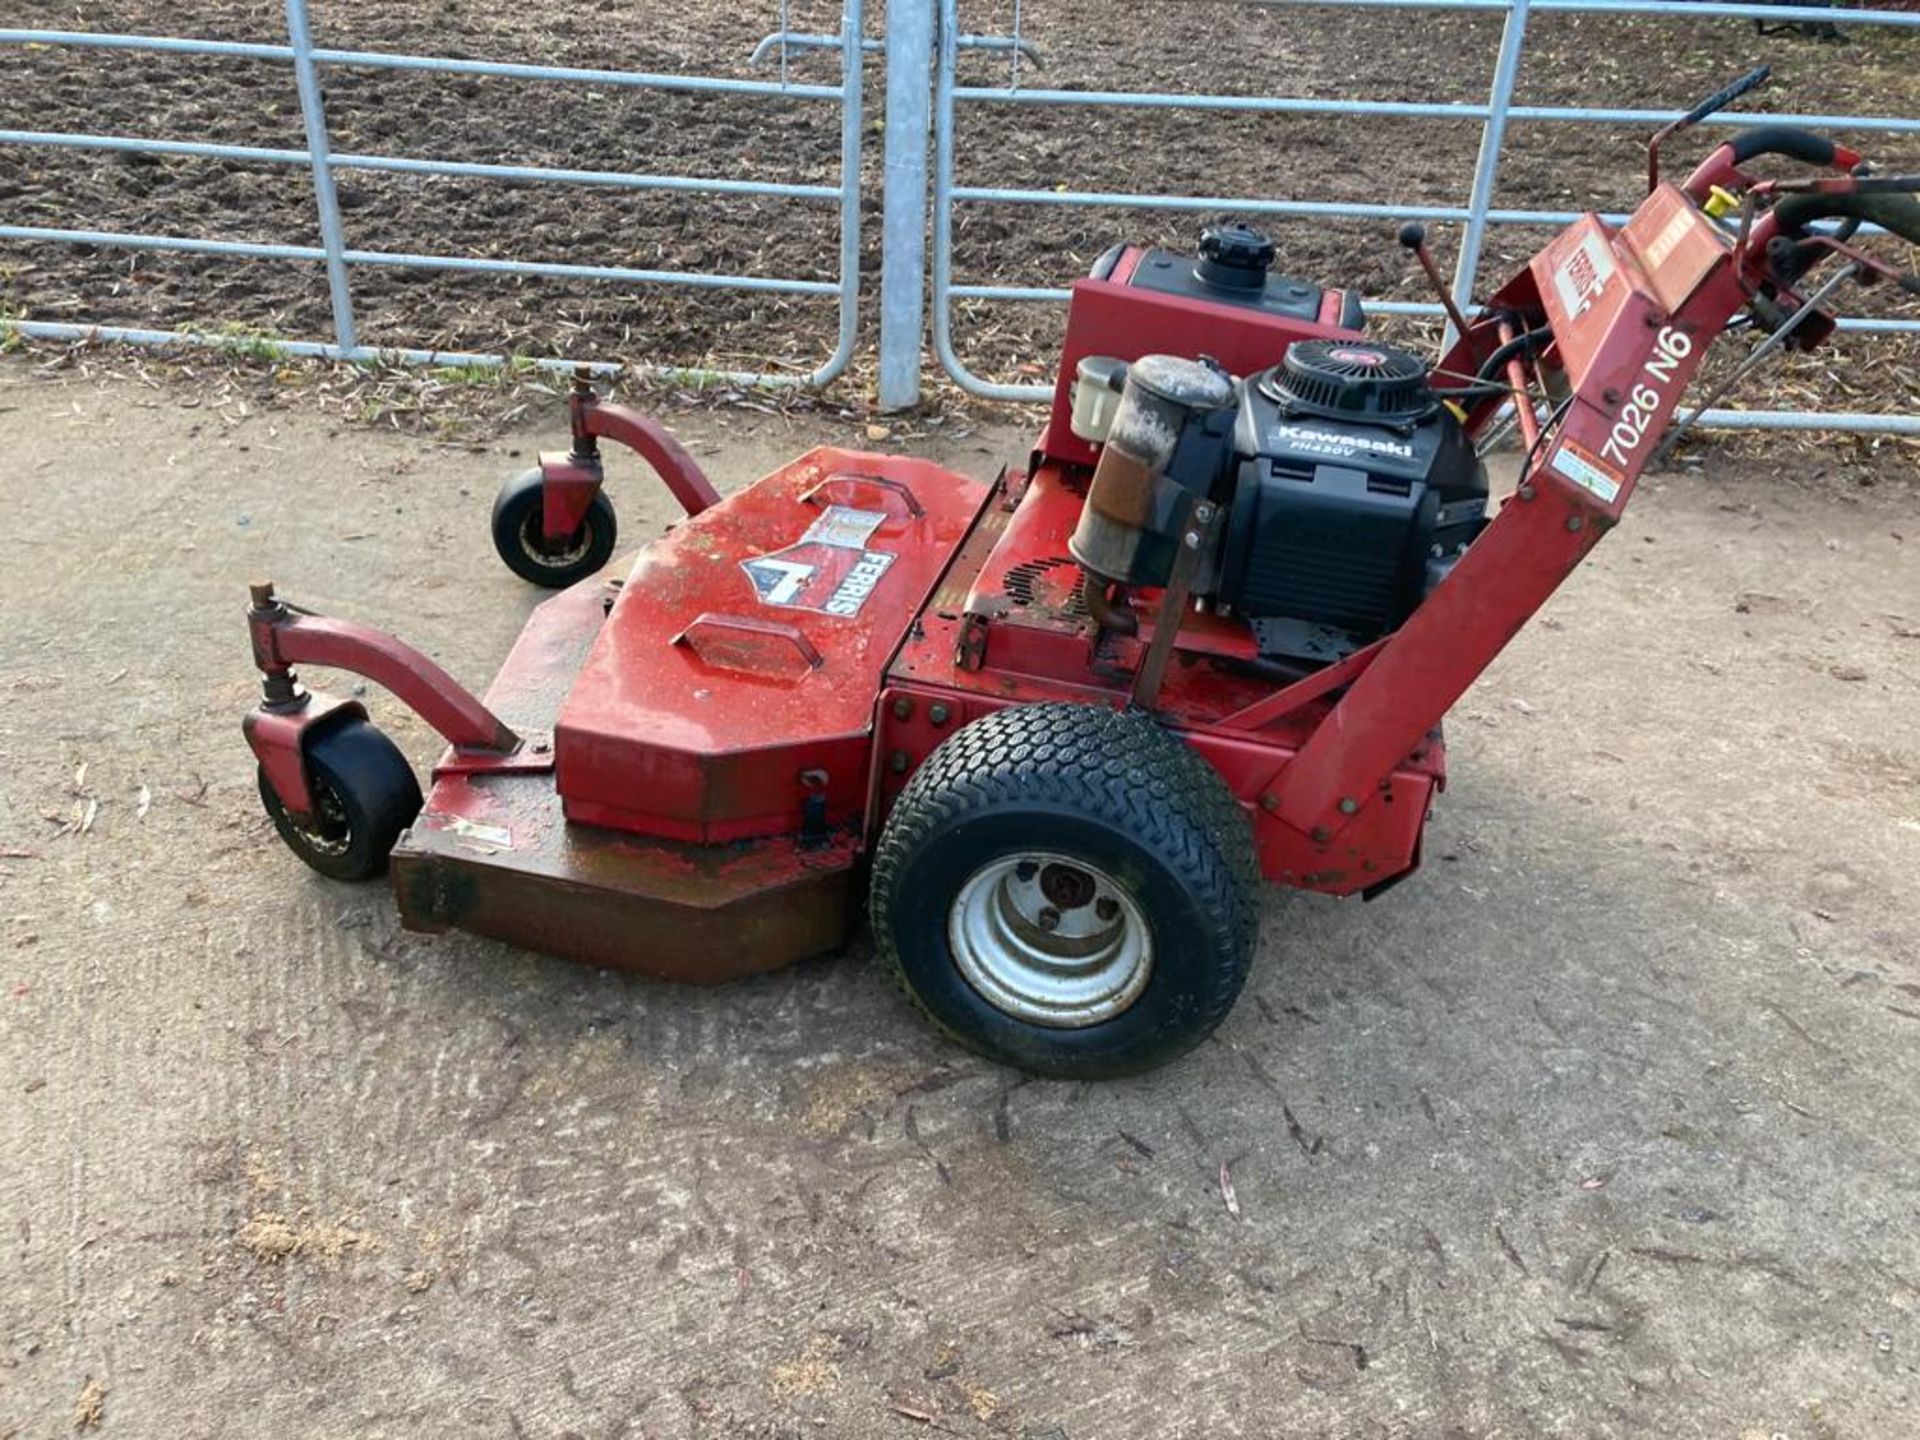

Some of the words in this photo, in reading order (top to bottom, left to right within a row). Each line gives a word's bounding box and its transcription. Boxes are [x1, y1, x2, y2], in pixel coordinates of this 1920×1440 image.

[1601, 384, 1660, 465] 7026
[1644, 326, 1692, 384] N6
[1278, 426, 1412, 457] Kawasaki
[825, 552, 893, 615] FERRIS
